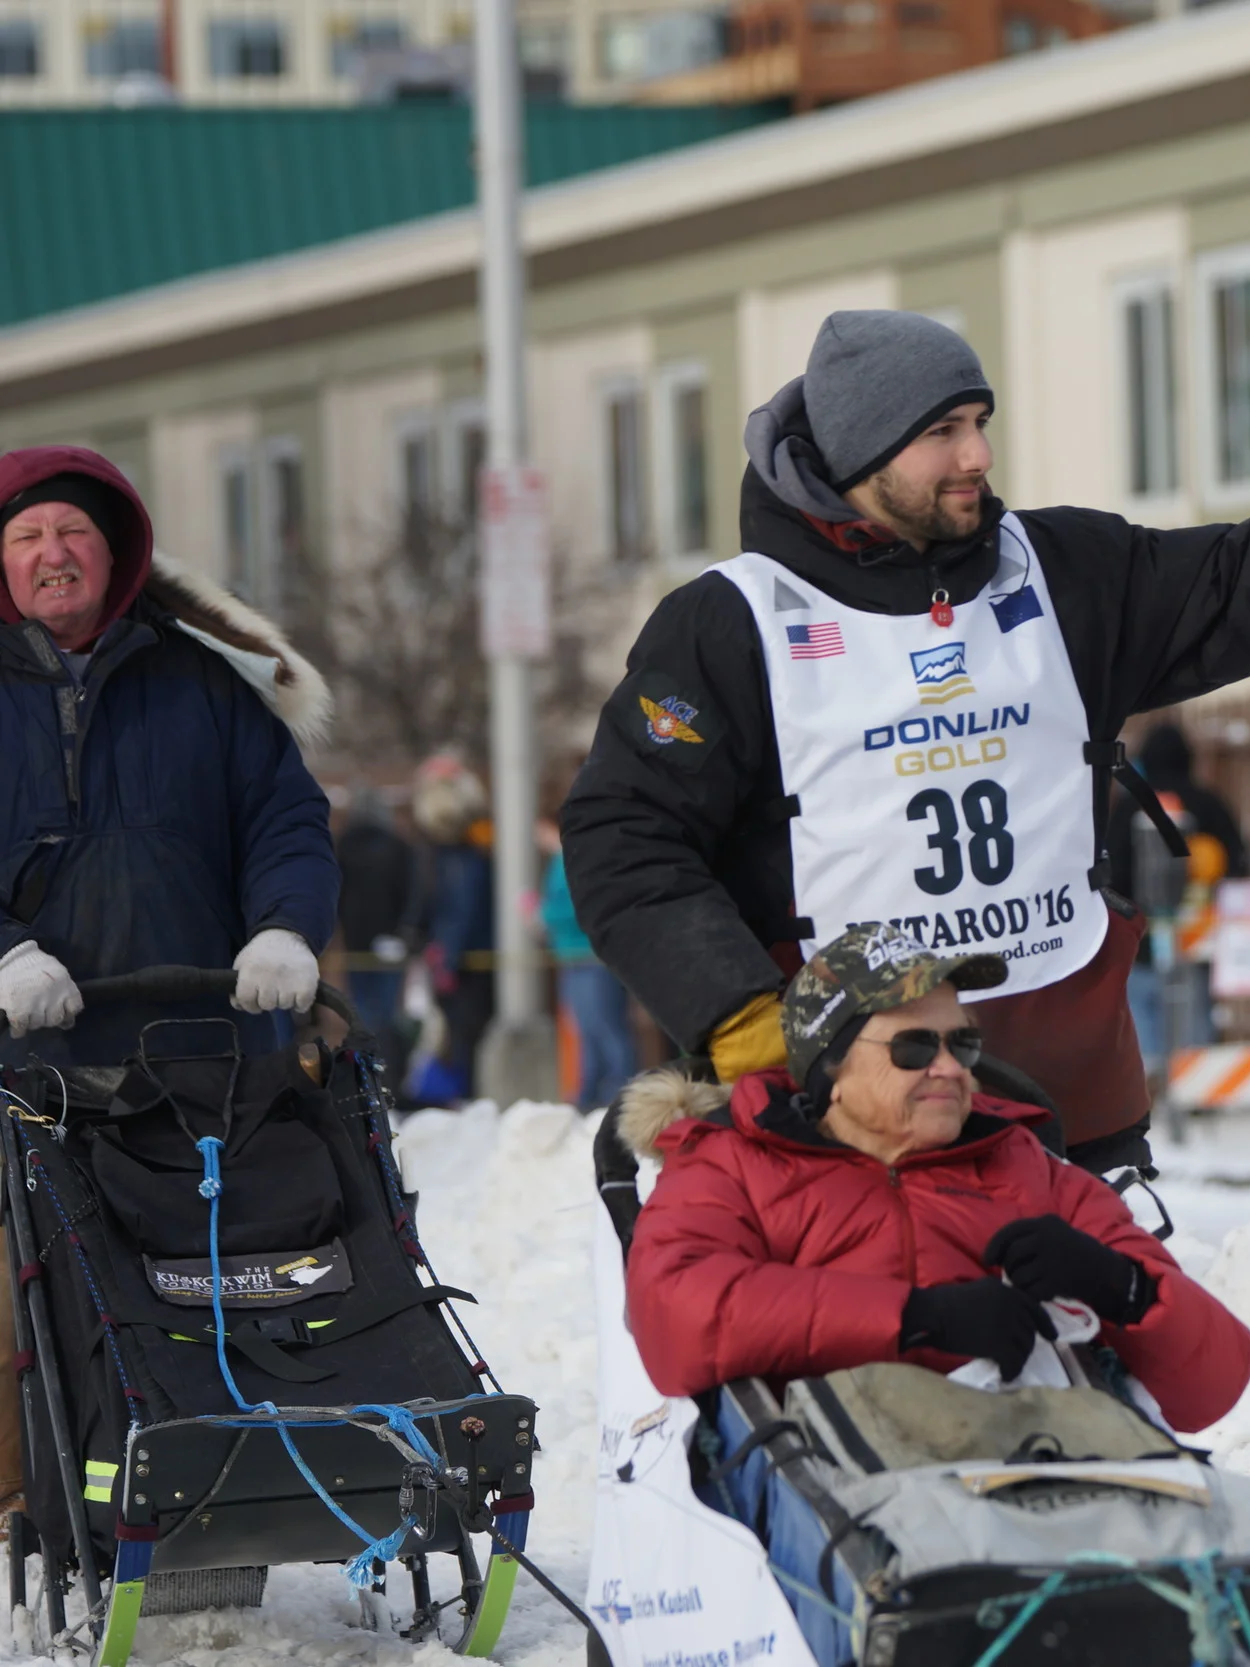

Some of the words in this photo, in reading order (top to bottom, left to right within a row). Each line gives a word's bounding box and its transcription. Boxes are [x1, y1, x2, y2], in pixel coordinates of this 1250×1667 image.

[658, 695, 700, 725] ACE
[863, 702, 1030, 752] DONLIN
[894, 736, 1007, 777] GOLD
[905, 779, 1015, 896] 38
[846, 897, 1030, 950] TAROD
[1034, 883, 1075, 928] '16
[245, 1265, 271, 1274] THE
